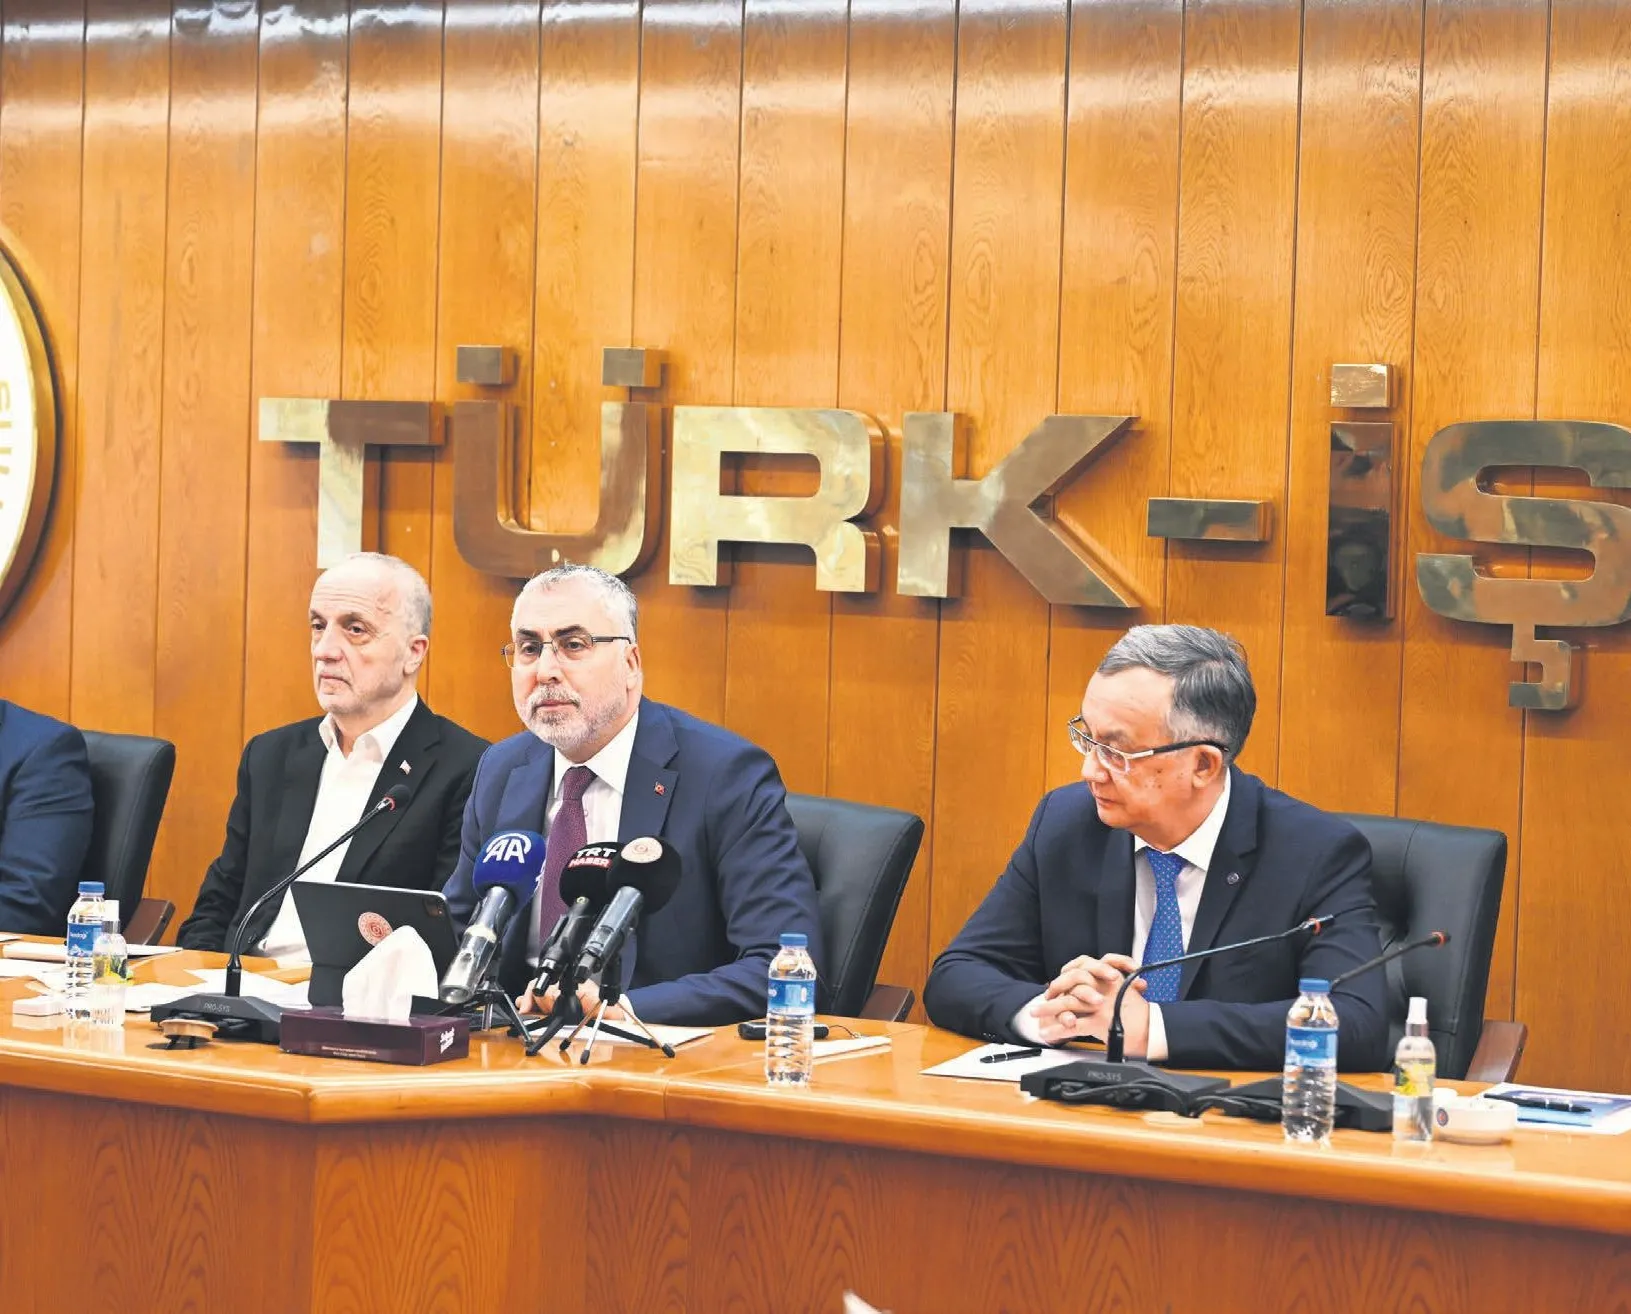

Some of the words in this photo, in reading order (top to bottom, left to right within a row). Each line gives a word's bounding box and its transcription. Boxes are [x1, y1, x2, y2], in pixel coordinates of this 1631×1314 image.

[259, 345, 1631, 711] TÜRK-İŞ
[482, 833, 532, 864] AA
[577, 847, 617, 859] TRT
[568, 857, 610, 869] HABER
